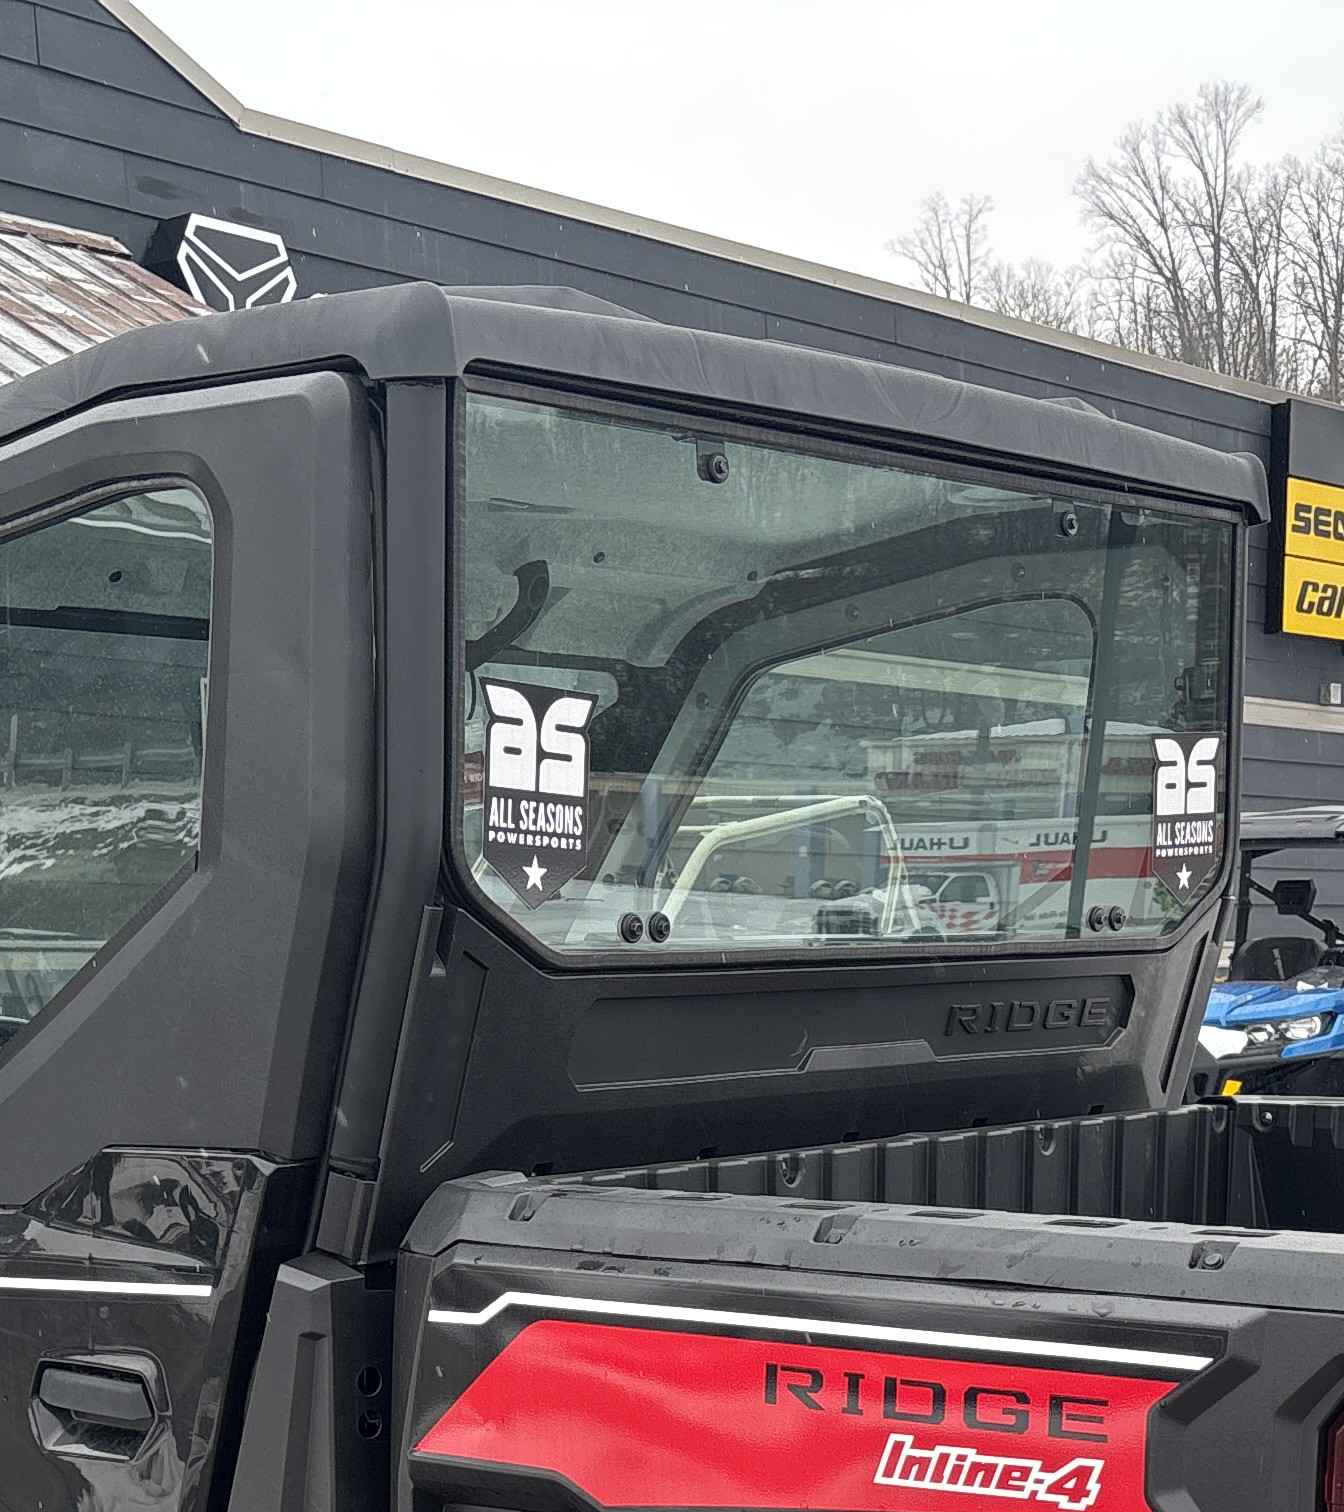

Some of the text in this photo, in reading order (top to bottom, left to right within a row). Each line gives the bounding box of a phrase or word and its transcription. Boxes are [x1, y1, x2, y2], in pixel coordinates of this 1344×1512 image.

[488, 796, 583, 836] ALL SEASONS
[1156, 819, 1214, 846] ALL SEASONS
[488, 830, 582, 851] POWERSPORTS
[1155, 845, 1213, 858] POWERSPORTS
[944, 997, 1111, 1037] RIDGE
[764, 1362, 1110, 1443] RIDGE
[873, 1433, 1105, 1511] Inline-4
